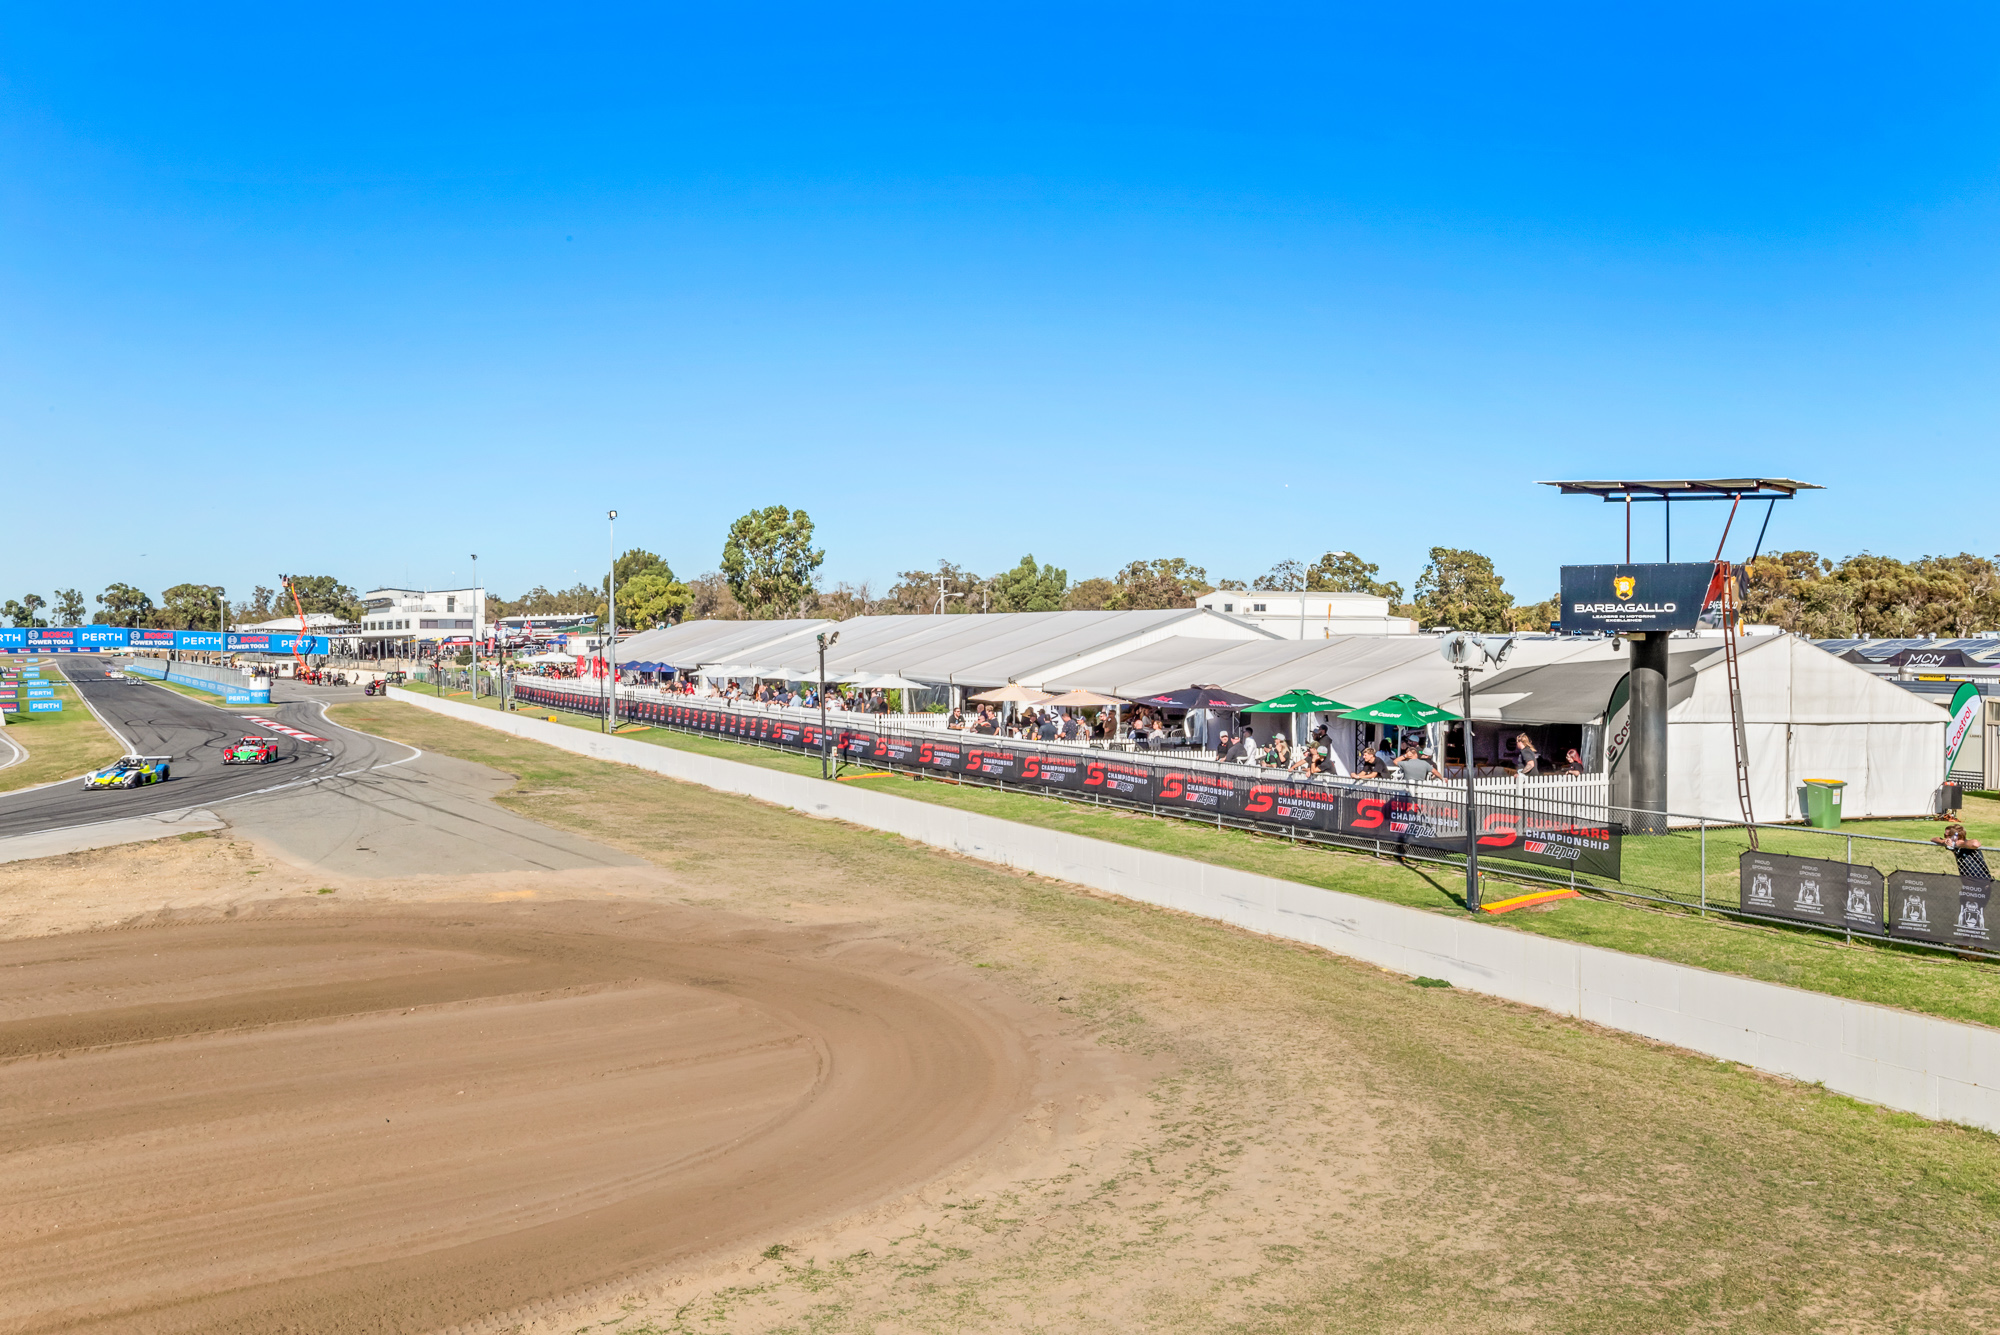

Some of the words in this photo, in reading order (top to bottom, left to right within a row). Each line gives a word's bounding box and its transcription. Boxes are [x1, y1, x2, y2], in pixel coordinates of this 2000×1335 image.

[1574, 603, 1676, 613] BARBAGALLO
[82, 633, 122, 641] PERTH
[183, 636, 221, 645] PERTH
[1904, 653, 1946, 668] MCM
[1952, 706, 1972, 747] Castrol
[1108, 764, 1147, 778] SUPERCARS
[1108, 772, 1147, 785] CHAMPIONSHIP
[1187, 775, 1233, 789] SUPERCARS
[1187, 784, 1234, 797] CHAMPIONSHIP
[1279, 787, 1334, 802] SUPERCARS
[1278, 797, 1334, 811] CHAMPIONSHIP
[1290, 807, 1315, 820] Repco
[1391, 812, 1459, 828] CHAMPIONSHIP
[1527, 817, 1609, 840] SUPERCARS
[1526, 830, 1609, 850] CHAMPIONSHIP
[1544, 842, 1580, 860] Repco
